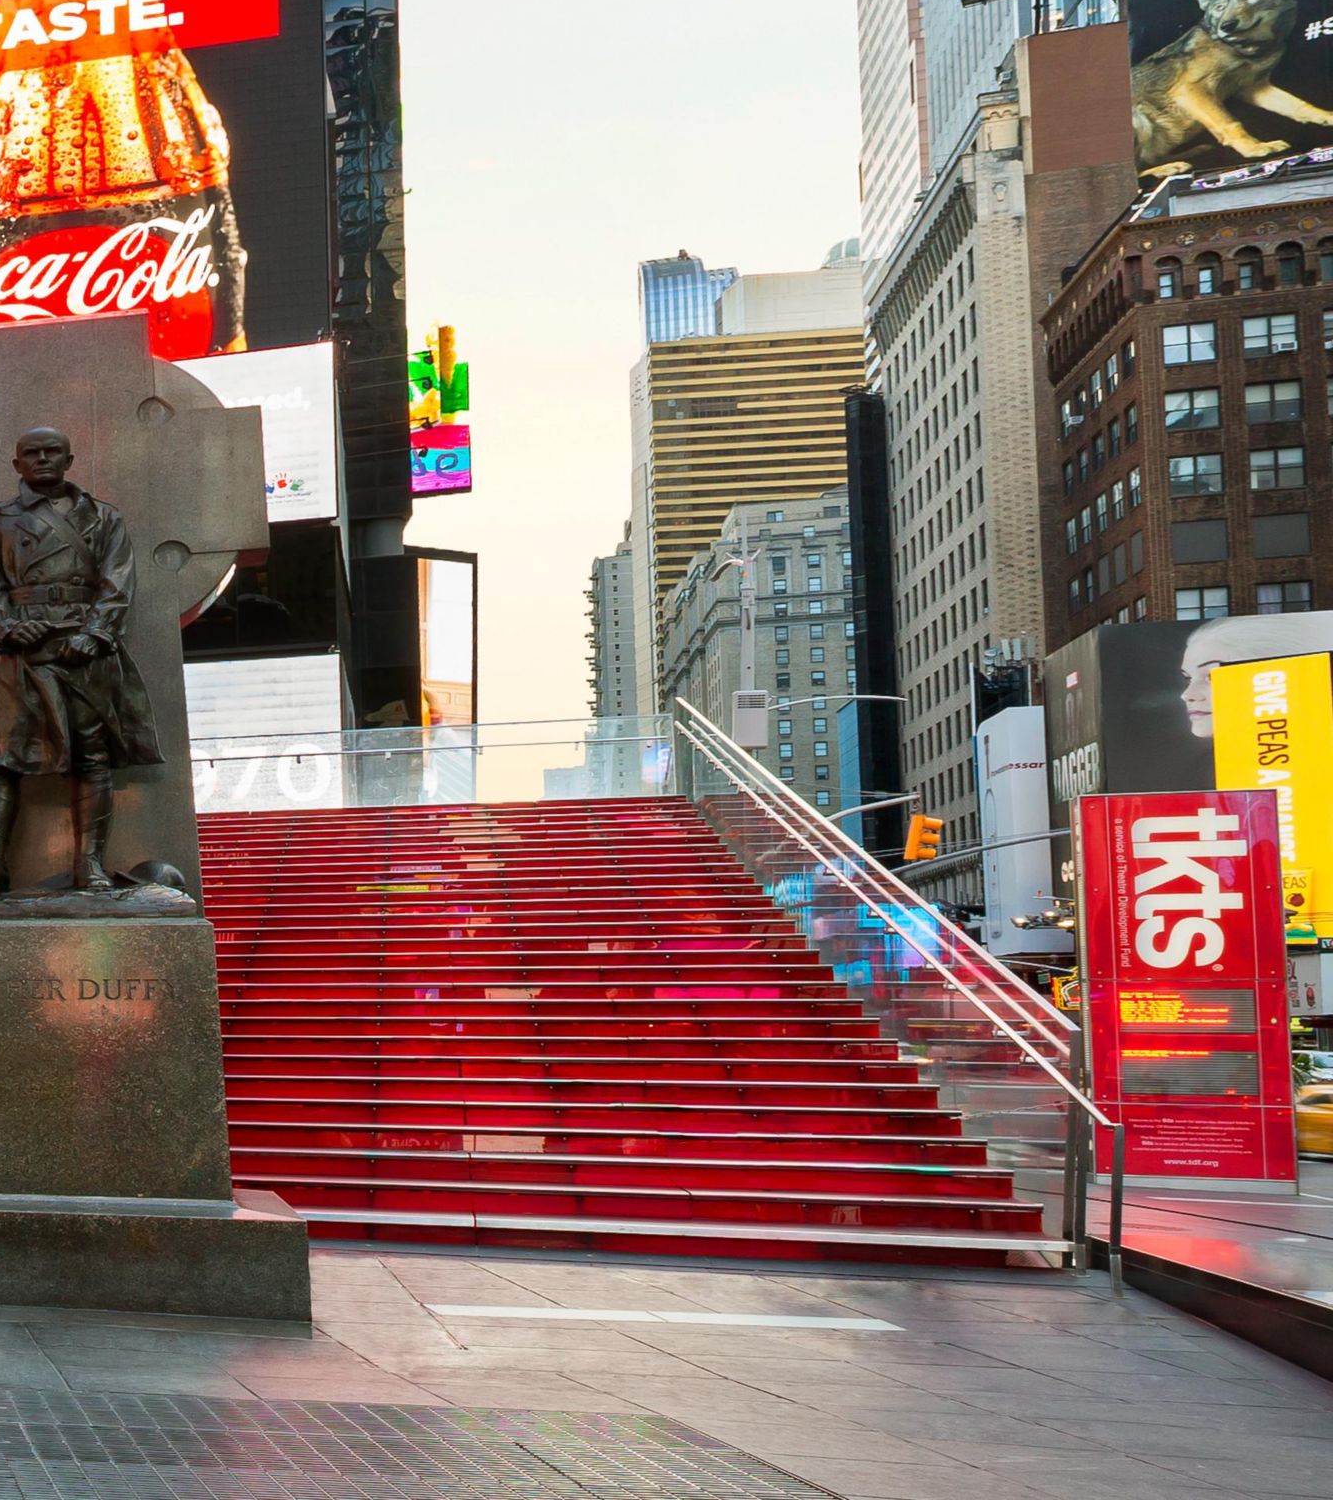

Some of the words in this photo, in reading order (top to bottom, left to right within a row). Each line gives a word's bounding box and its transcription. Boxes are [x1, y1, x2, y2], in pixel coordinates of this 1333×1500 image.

[1253, 670, 1287, 717] GIVE
[1257, 719, 1290, 766] PEAS
[1053, 742, 1100, 802] DAGGER
[1257, 769, 1292, 785] A
[1114, 826, 1122, 849] service
[1116, 860, 1127, 894] Theatre
[1118, 896, 1130, 947] Development
[1121, 950, 1131, 968] Fund
[77, 978, 180, 1002] DUFFY
